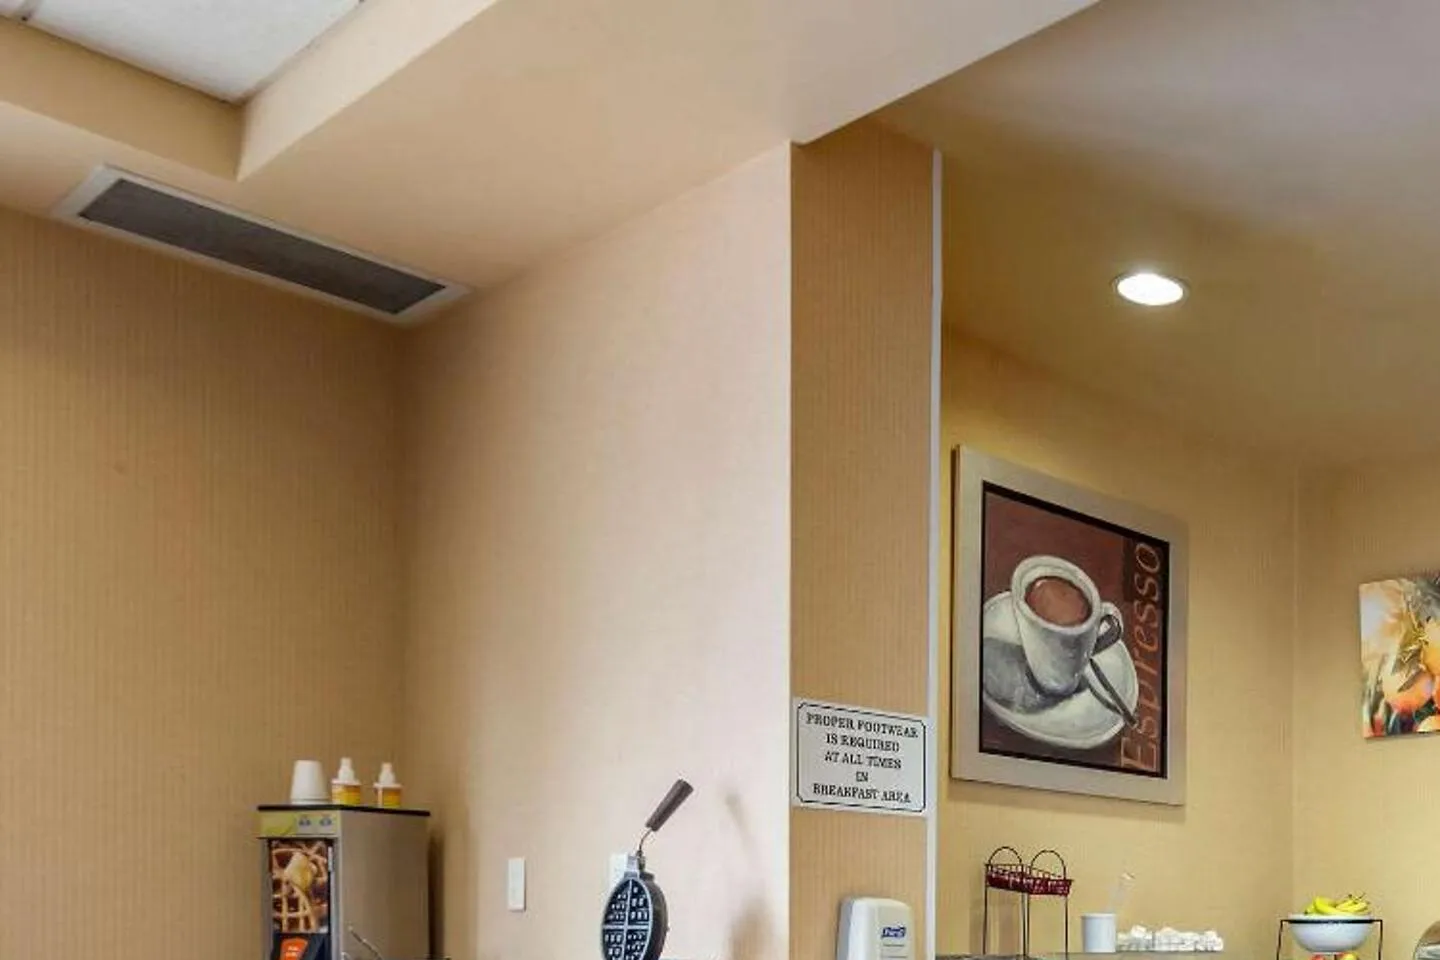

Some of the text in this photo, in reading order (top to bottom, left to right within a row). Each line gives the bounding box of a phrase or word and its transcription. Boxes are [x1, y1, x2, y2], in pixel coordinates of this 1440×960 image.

[1120, 541, 1163, 773] Espresso
[806, 712, 919, 738] PROPER FOOTWEAR
[826, 733, 900, 752] IS REQUIRED
[824, 751, 902, 769] AT ALL TIMES
[855, 771, 869, 783] IN
[813, 783, 912, 804] BREAKFAST AREA
